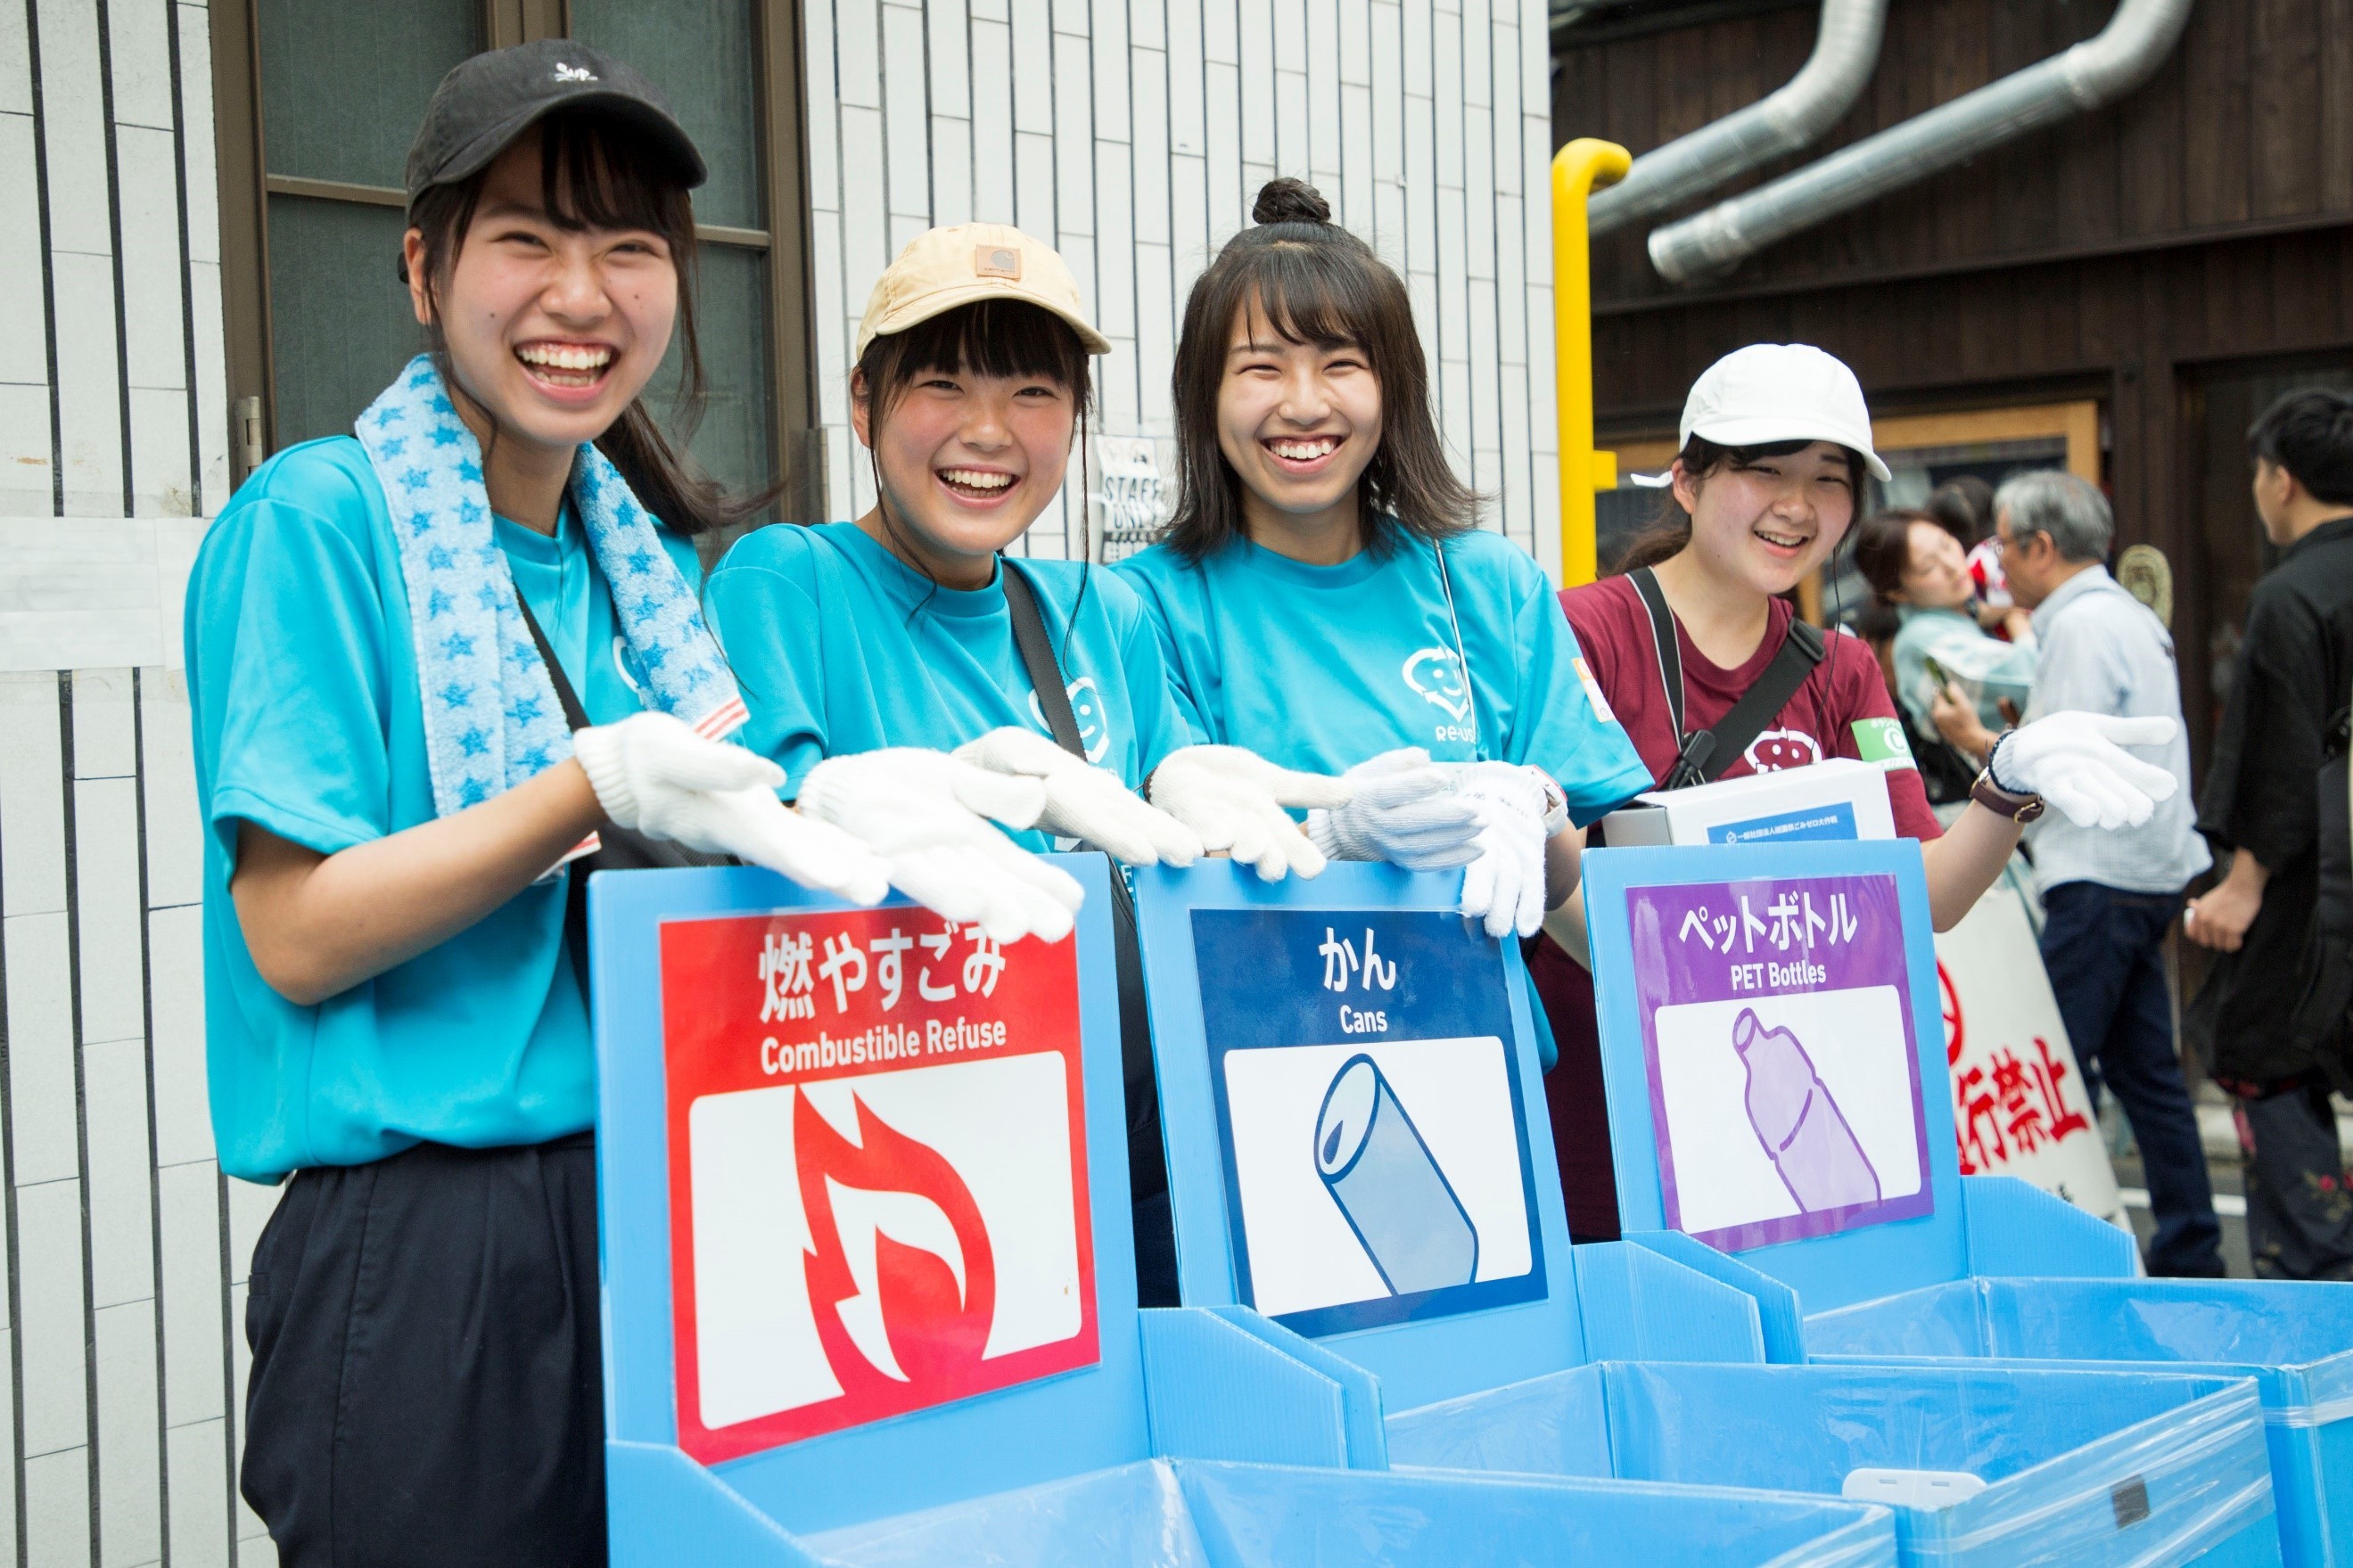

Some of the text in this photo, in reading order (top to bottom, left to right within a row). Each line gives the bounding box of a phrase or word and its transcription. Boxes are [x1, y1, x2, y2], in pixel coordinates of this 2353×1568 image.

[1105, 475, 1161, 501] STAFF
[1678, 890, 1858, 956] ペットボトル
[758, 921, 1007, 1023] 燃やすごみ
[1318, 926, 1396, 992] かん
[1730, 959, 1827, 991] PET Bottles
[760, 1015, 1008, 1076] Combustible Refuse
[1339, 1004, 1388, 1034] Cans
[1955, 1037, 2088, 1176] 行禁止
